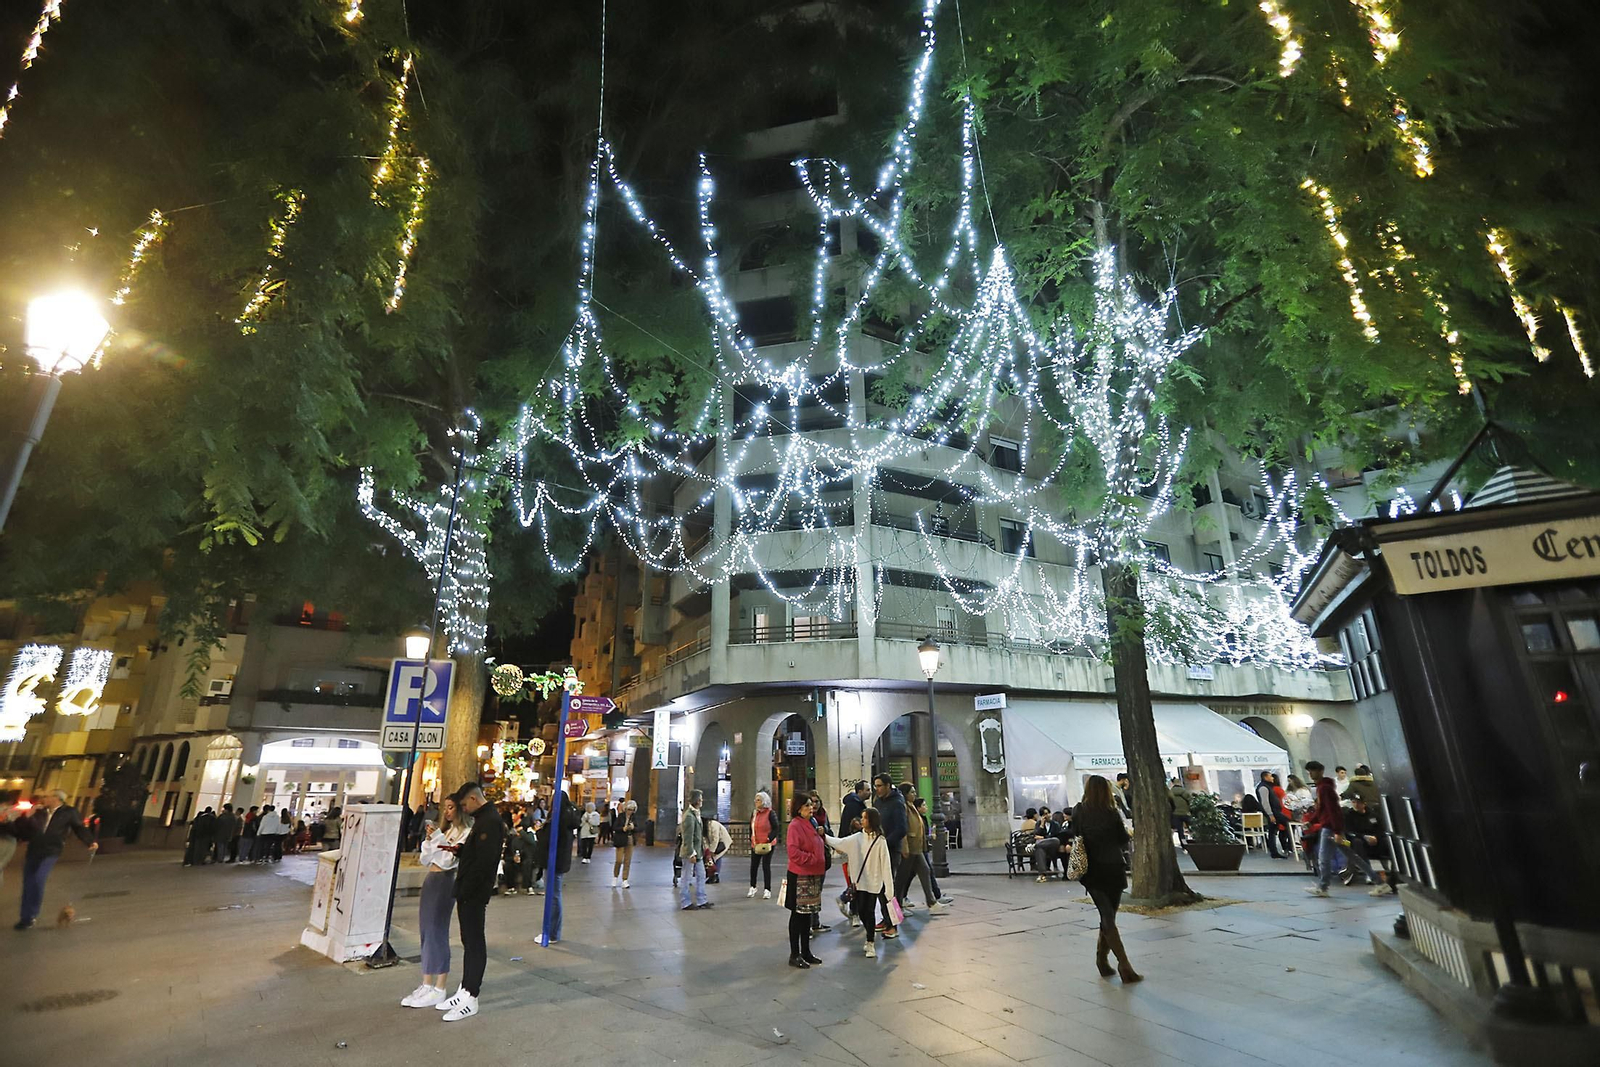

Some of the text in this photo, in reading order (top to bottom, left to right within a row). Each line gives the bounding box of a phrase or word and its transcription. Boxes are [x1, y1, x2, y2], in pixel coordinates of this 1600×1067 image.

[1410, 545, 1487, 580] TOLDOS
[394, 666, 438, 715] P
[388, 731, 438, 744] CASA OLON
[1091, 757, 1121, 766] FARMACIA
